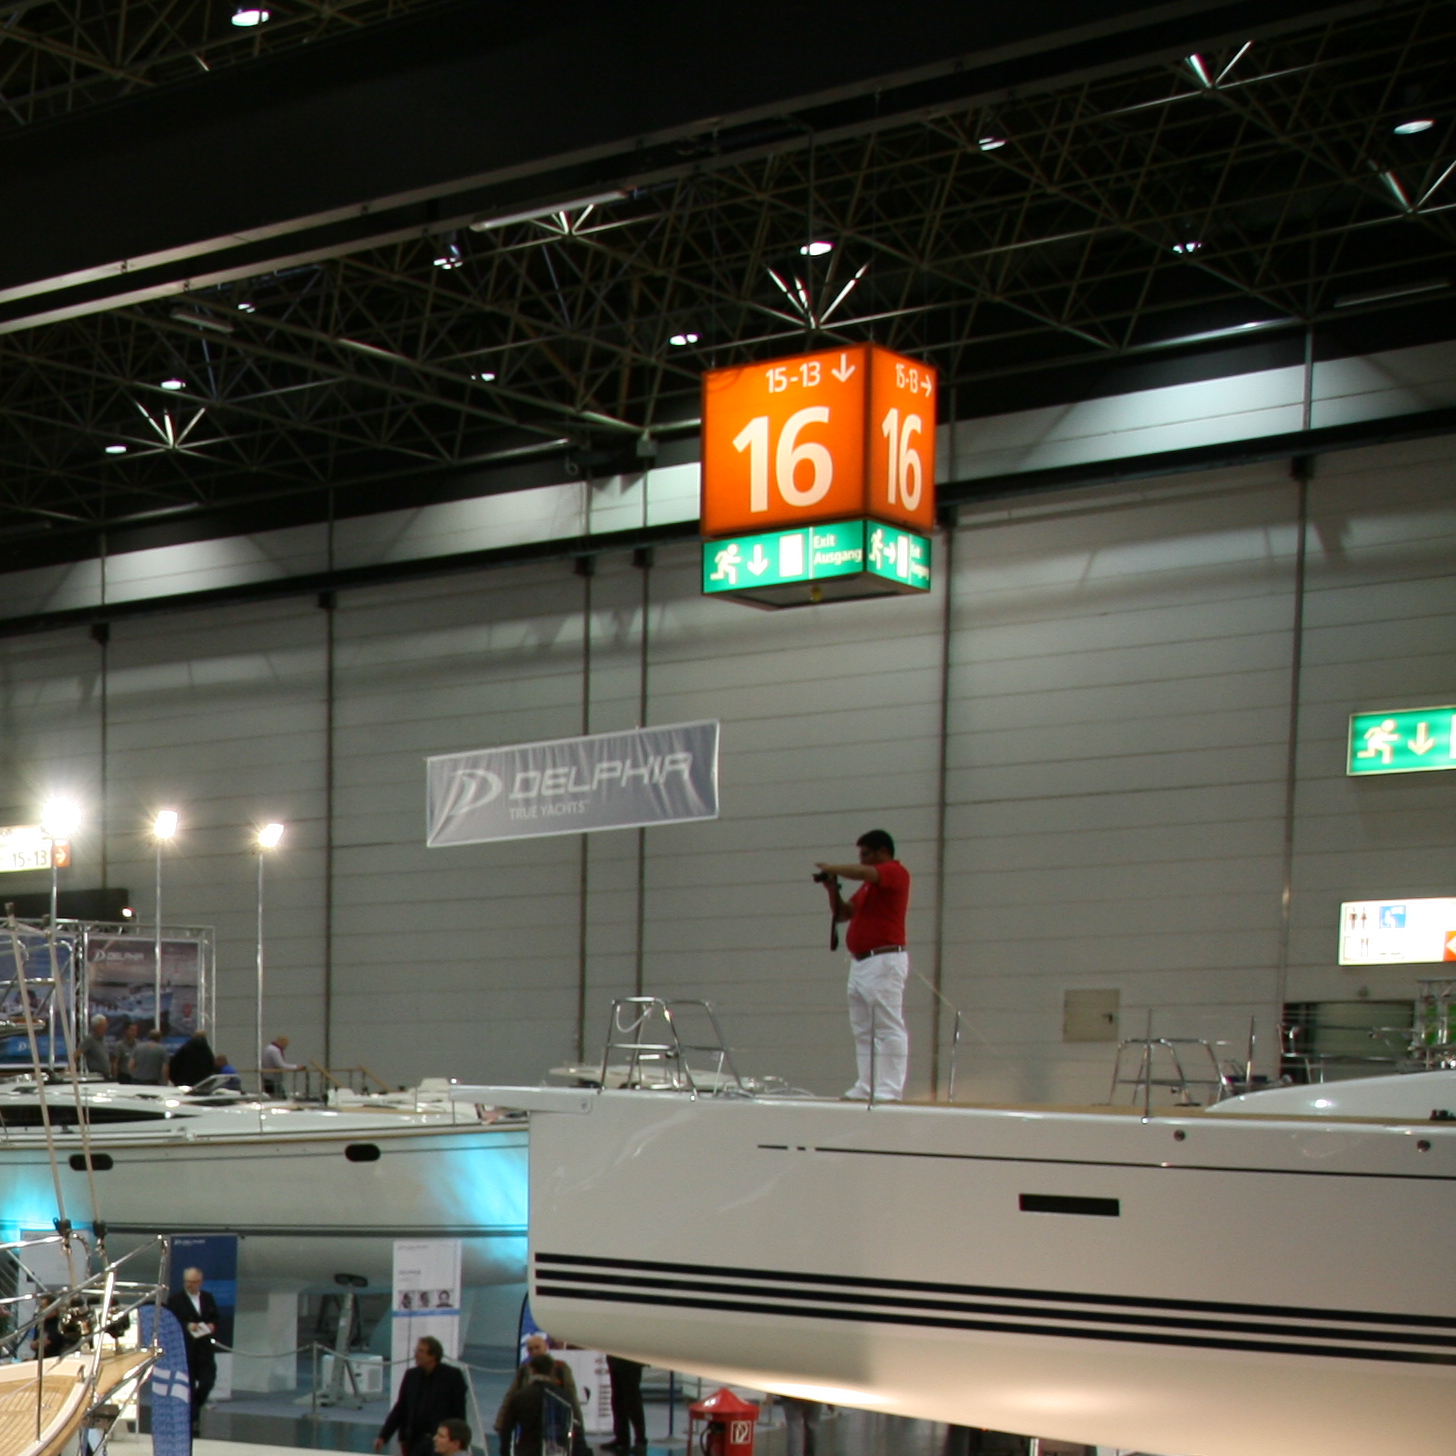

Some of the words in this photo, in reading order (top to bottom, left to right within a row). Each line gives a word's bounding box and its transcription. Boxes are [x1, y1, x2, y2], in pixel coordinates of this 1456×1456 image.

[766, 361, 821, 393] 15-13
[732, 405, 834, 513] 16
[881, 407, 923, 512] 16
[813, 534, 836, 549] Exit
[813, 549, 863, 565] Ausgang
[509, 806, 538, 820] TRUE
[540, 803, 586, 817] YACHTS
